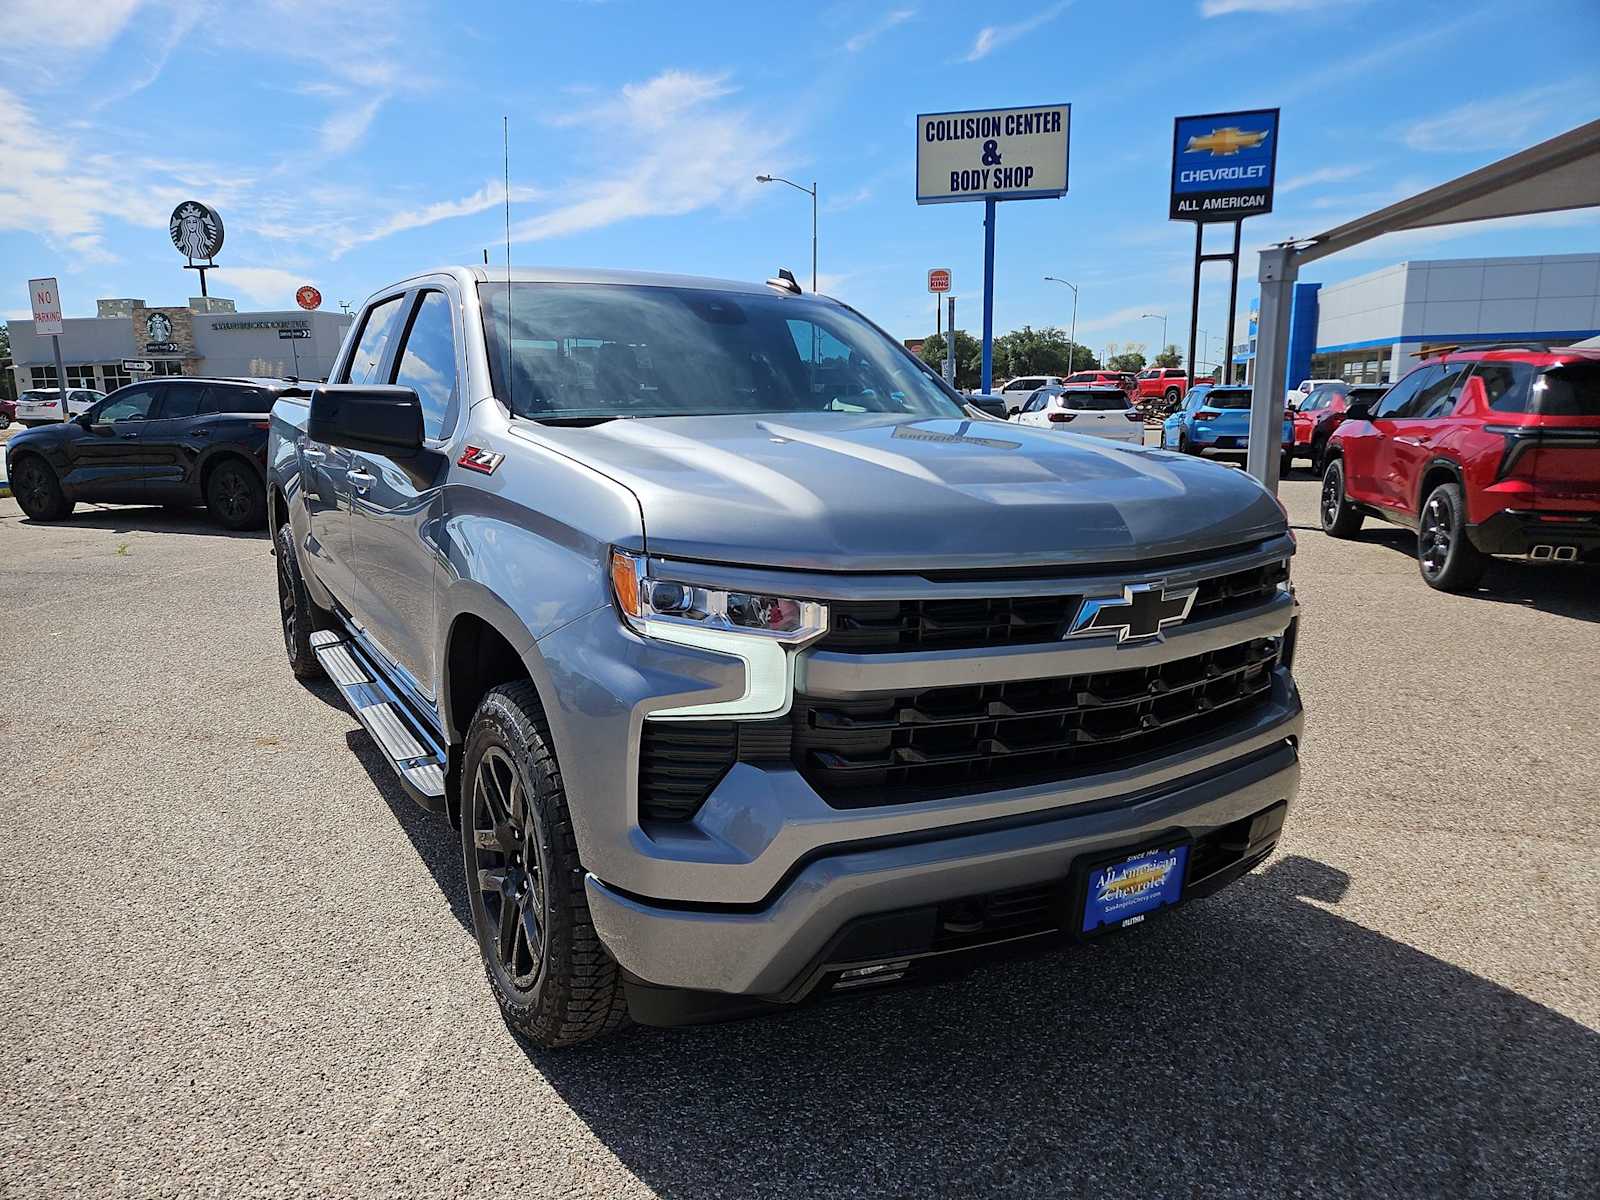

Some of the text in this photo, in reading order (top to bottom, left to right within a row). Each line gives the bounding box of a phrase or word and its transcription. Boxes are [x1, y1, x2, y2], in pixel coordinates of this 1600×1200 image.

[925, 111, 1061, 142] COLLISION CENTER
[981, 139, 1002, 166] &
[950, 166, 1034, 192] BODY SHOP
[1180, 165, 1267, 183] CHEVROLET
[1178, 195, 1265, 211] ALL AMERICAN
[930, 280, 949, 288] KING
[37, 291, 51, 304] NO
[34, 311, 60, 322] PARKING
[457, 444, 505, 476] Z71
[1095, 856, 1177, 889] All American
[1104, 875, 1166, 901] Chevrolet
